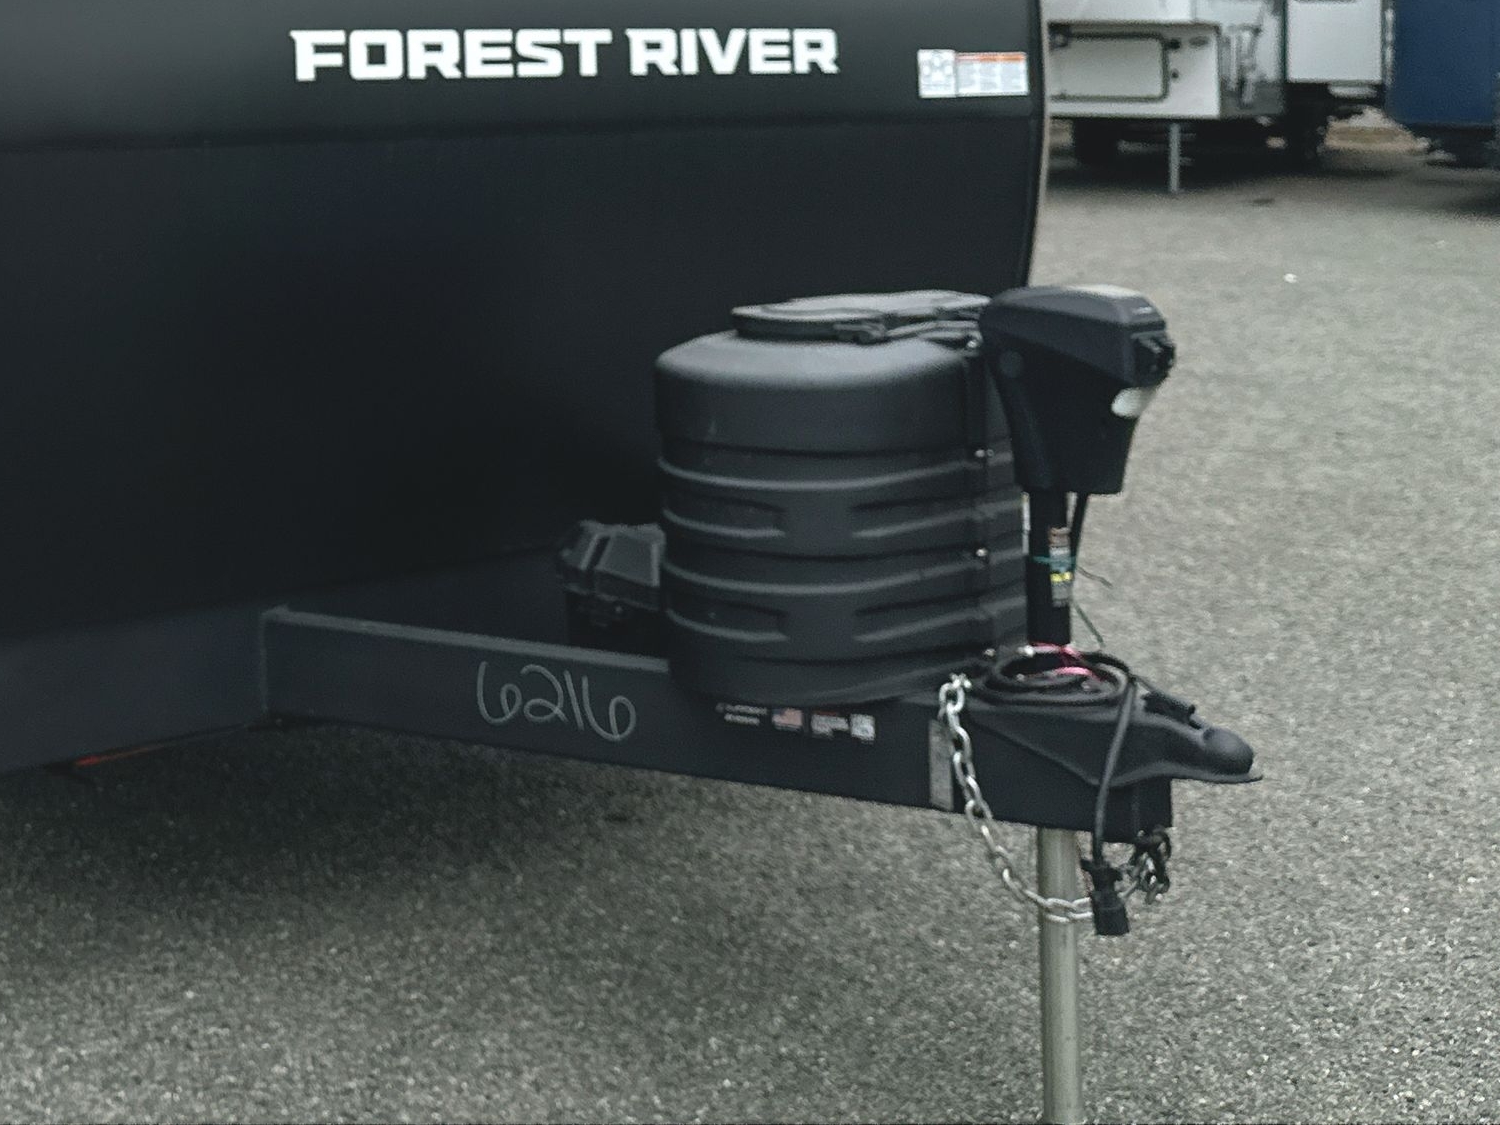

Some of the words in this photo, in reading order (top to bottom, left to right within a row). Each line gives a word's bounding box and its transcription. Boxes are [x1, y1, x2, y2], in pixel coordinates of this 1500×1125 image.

[289, 28, 613, 81] FOREST
[625, 27, 840, 76] RIVER
[476, 661, 637, 742] 6216
